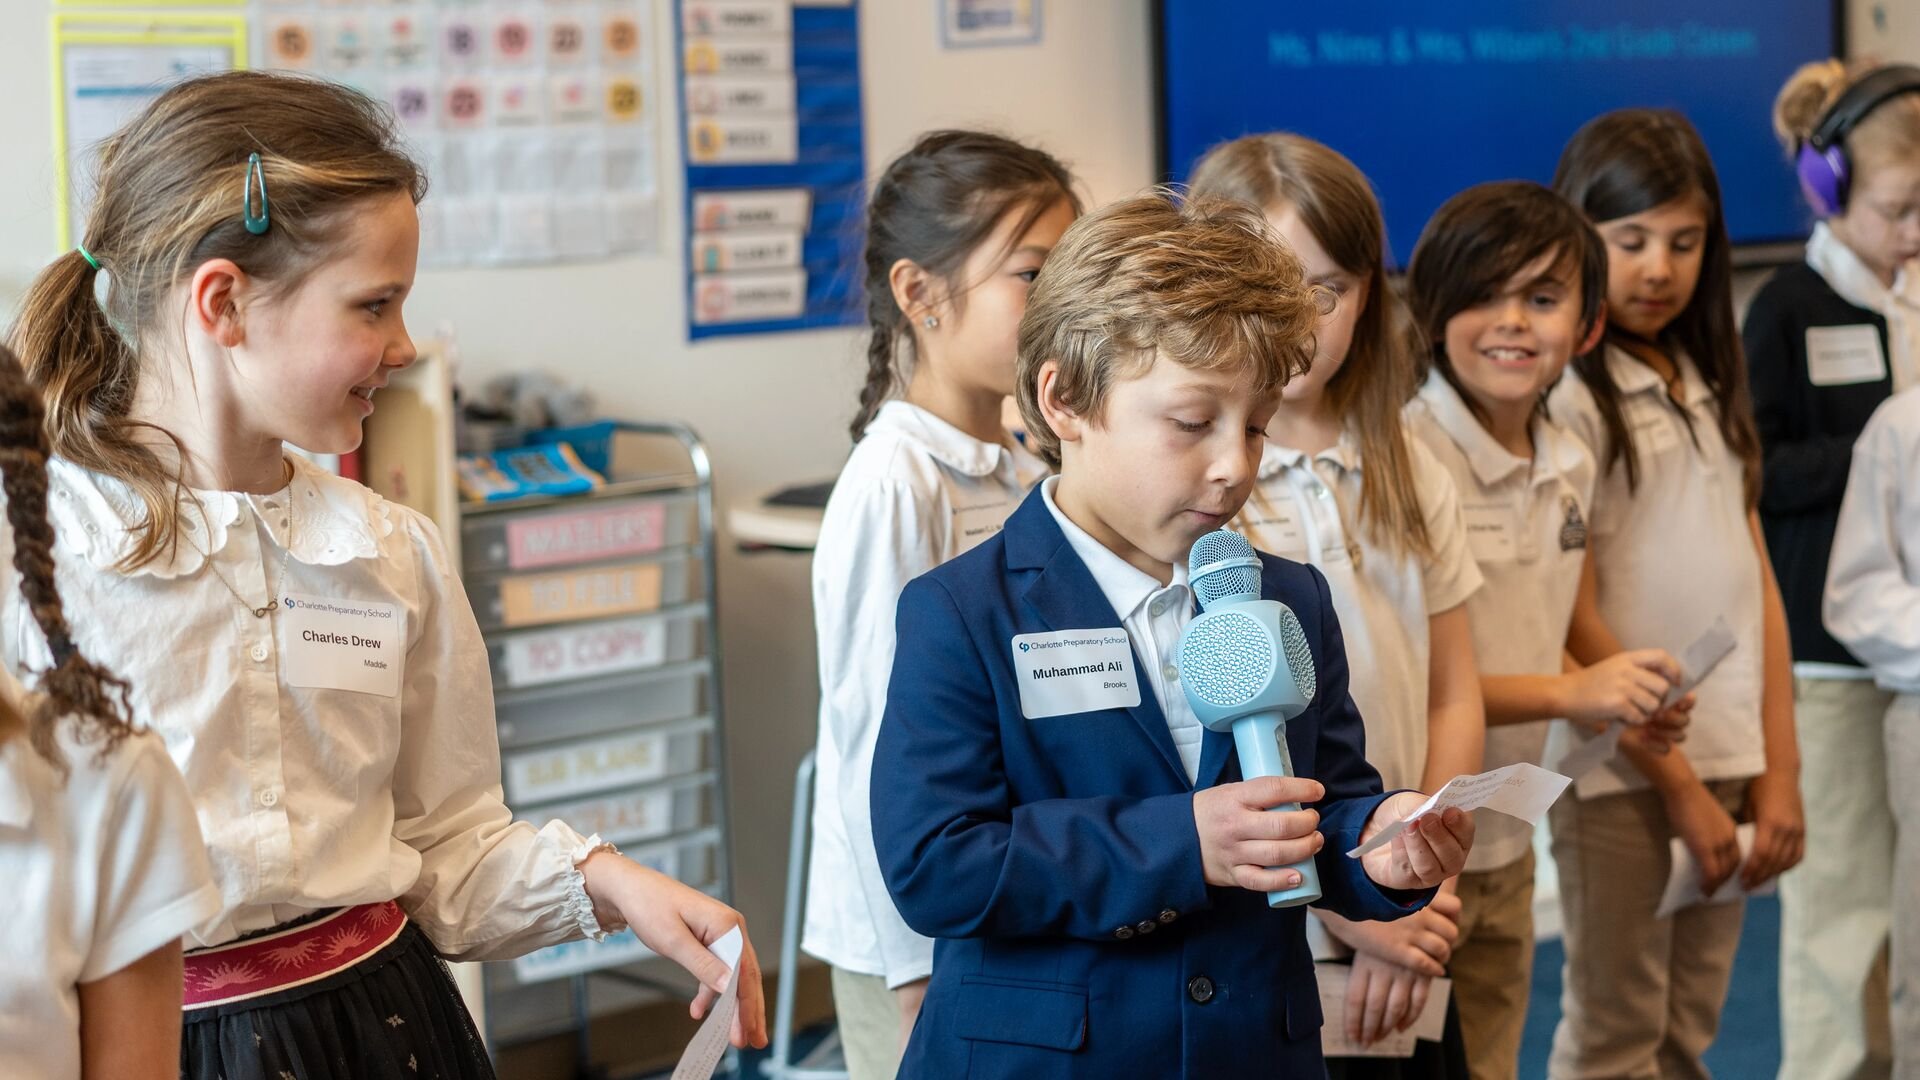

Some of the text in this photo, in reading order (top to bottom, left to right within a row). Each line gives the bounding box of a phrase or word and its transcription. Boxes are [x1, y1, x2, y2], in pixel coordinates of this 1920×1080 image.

[524, 511, 652, 554] MAILERS
[531, 571, 636, 611] TO FILE
[296, 600, 328, 611] Charlotte
[327, 604, 368, 618] Preparatory
[367, 608, 392, 619] School
[302, 629, 382, 649] Charles Drew
[526, 625, 645, 672] TO COPY
[1030, 641, 1063, 650] Charlotte
[1063, 638, 1104, 647] Preparatory
[363, 659, 388, 670] Maddie
[1033, 661, 1123, 680] Muhammad Ali
[1103, 681, 1127, 689] Brooks
